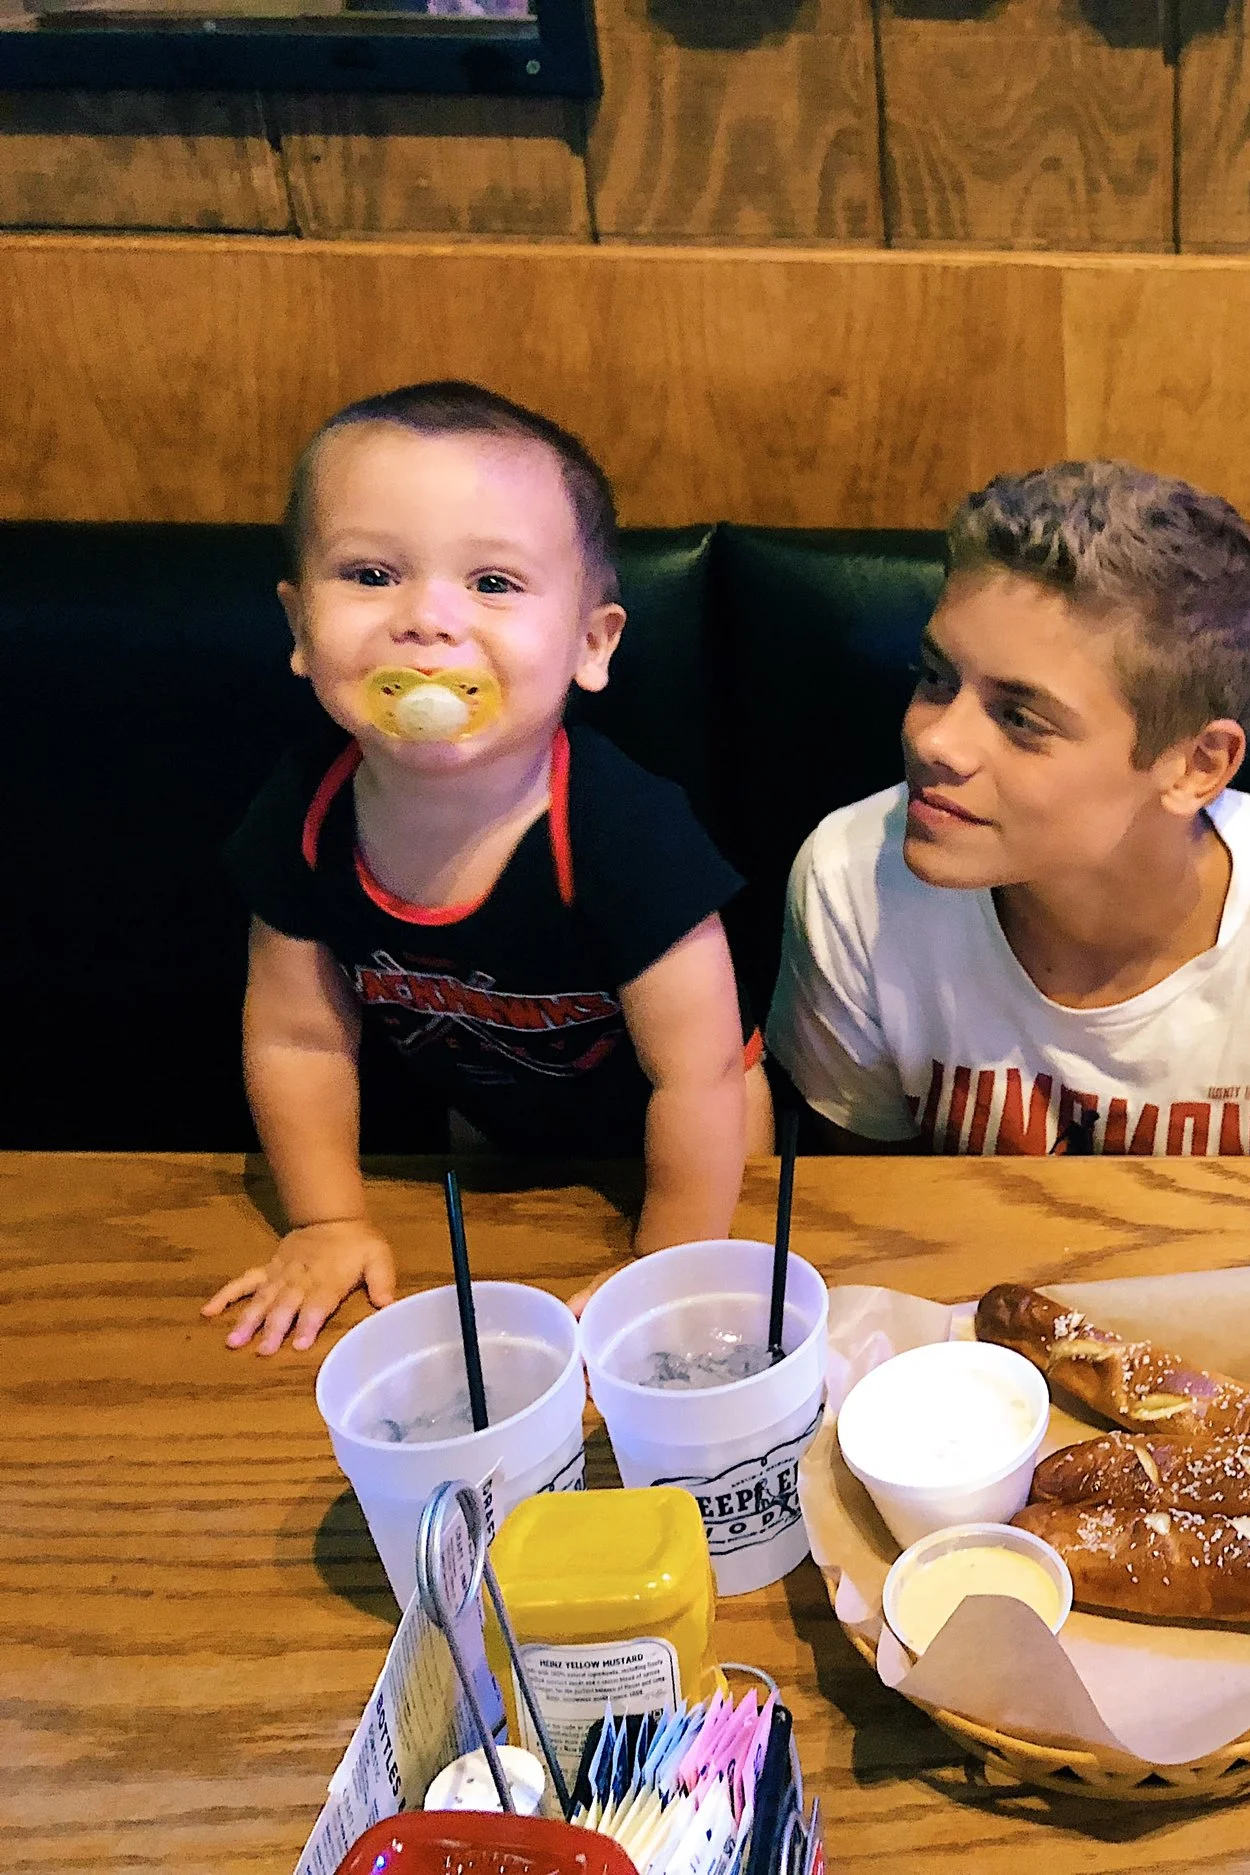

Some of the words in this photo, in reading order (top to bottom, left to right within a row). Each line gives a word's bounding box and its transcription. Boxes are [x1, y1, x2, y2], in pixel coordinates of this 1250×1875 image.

[696, 1489, 754, 1518] EEP
[540, 1659, 562, 1668] HEINZ
[566, 1659, 600, 1670] YELLOW
[603, 1653, 644, 1668] MUSTARD
[376, 1692, 402, 1797] BOTTLES
